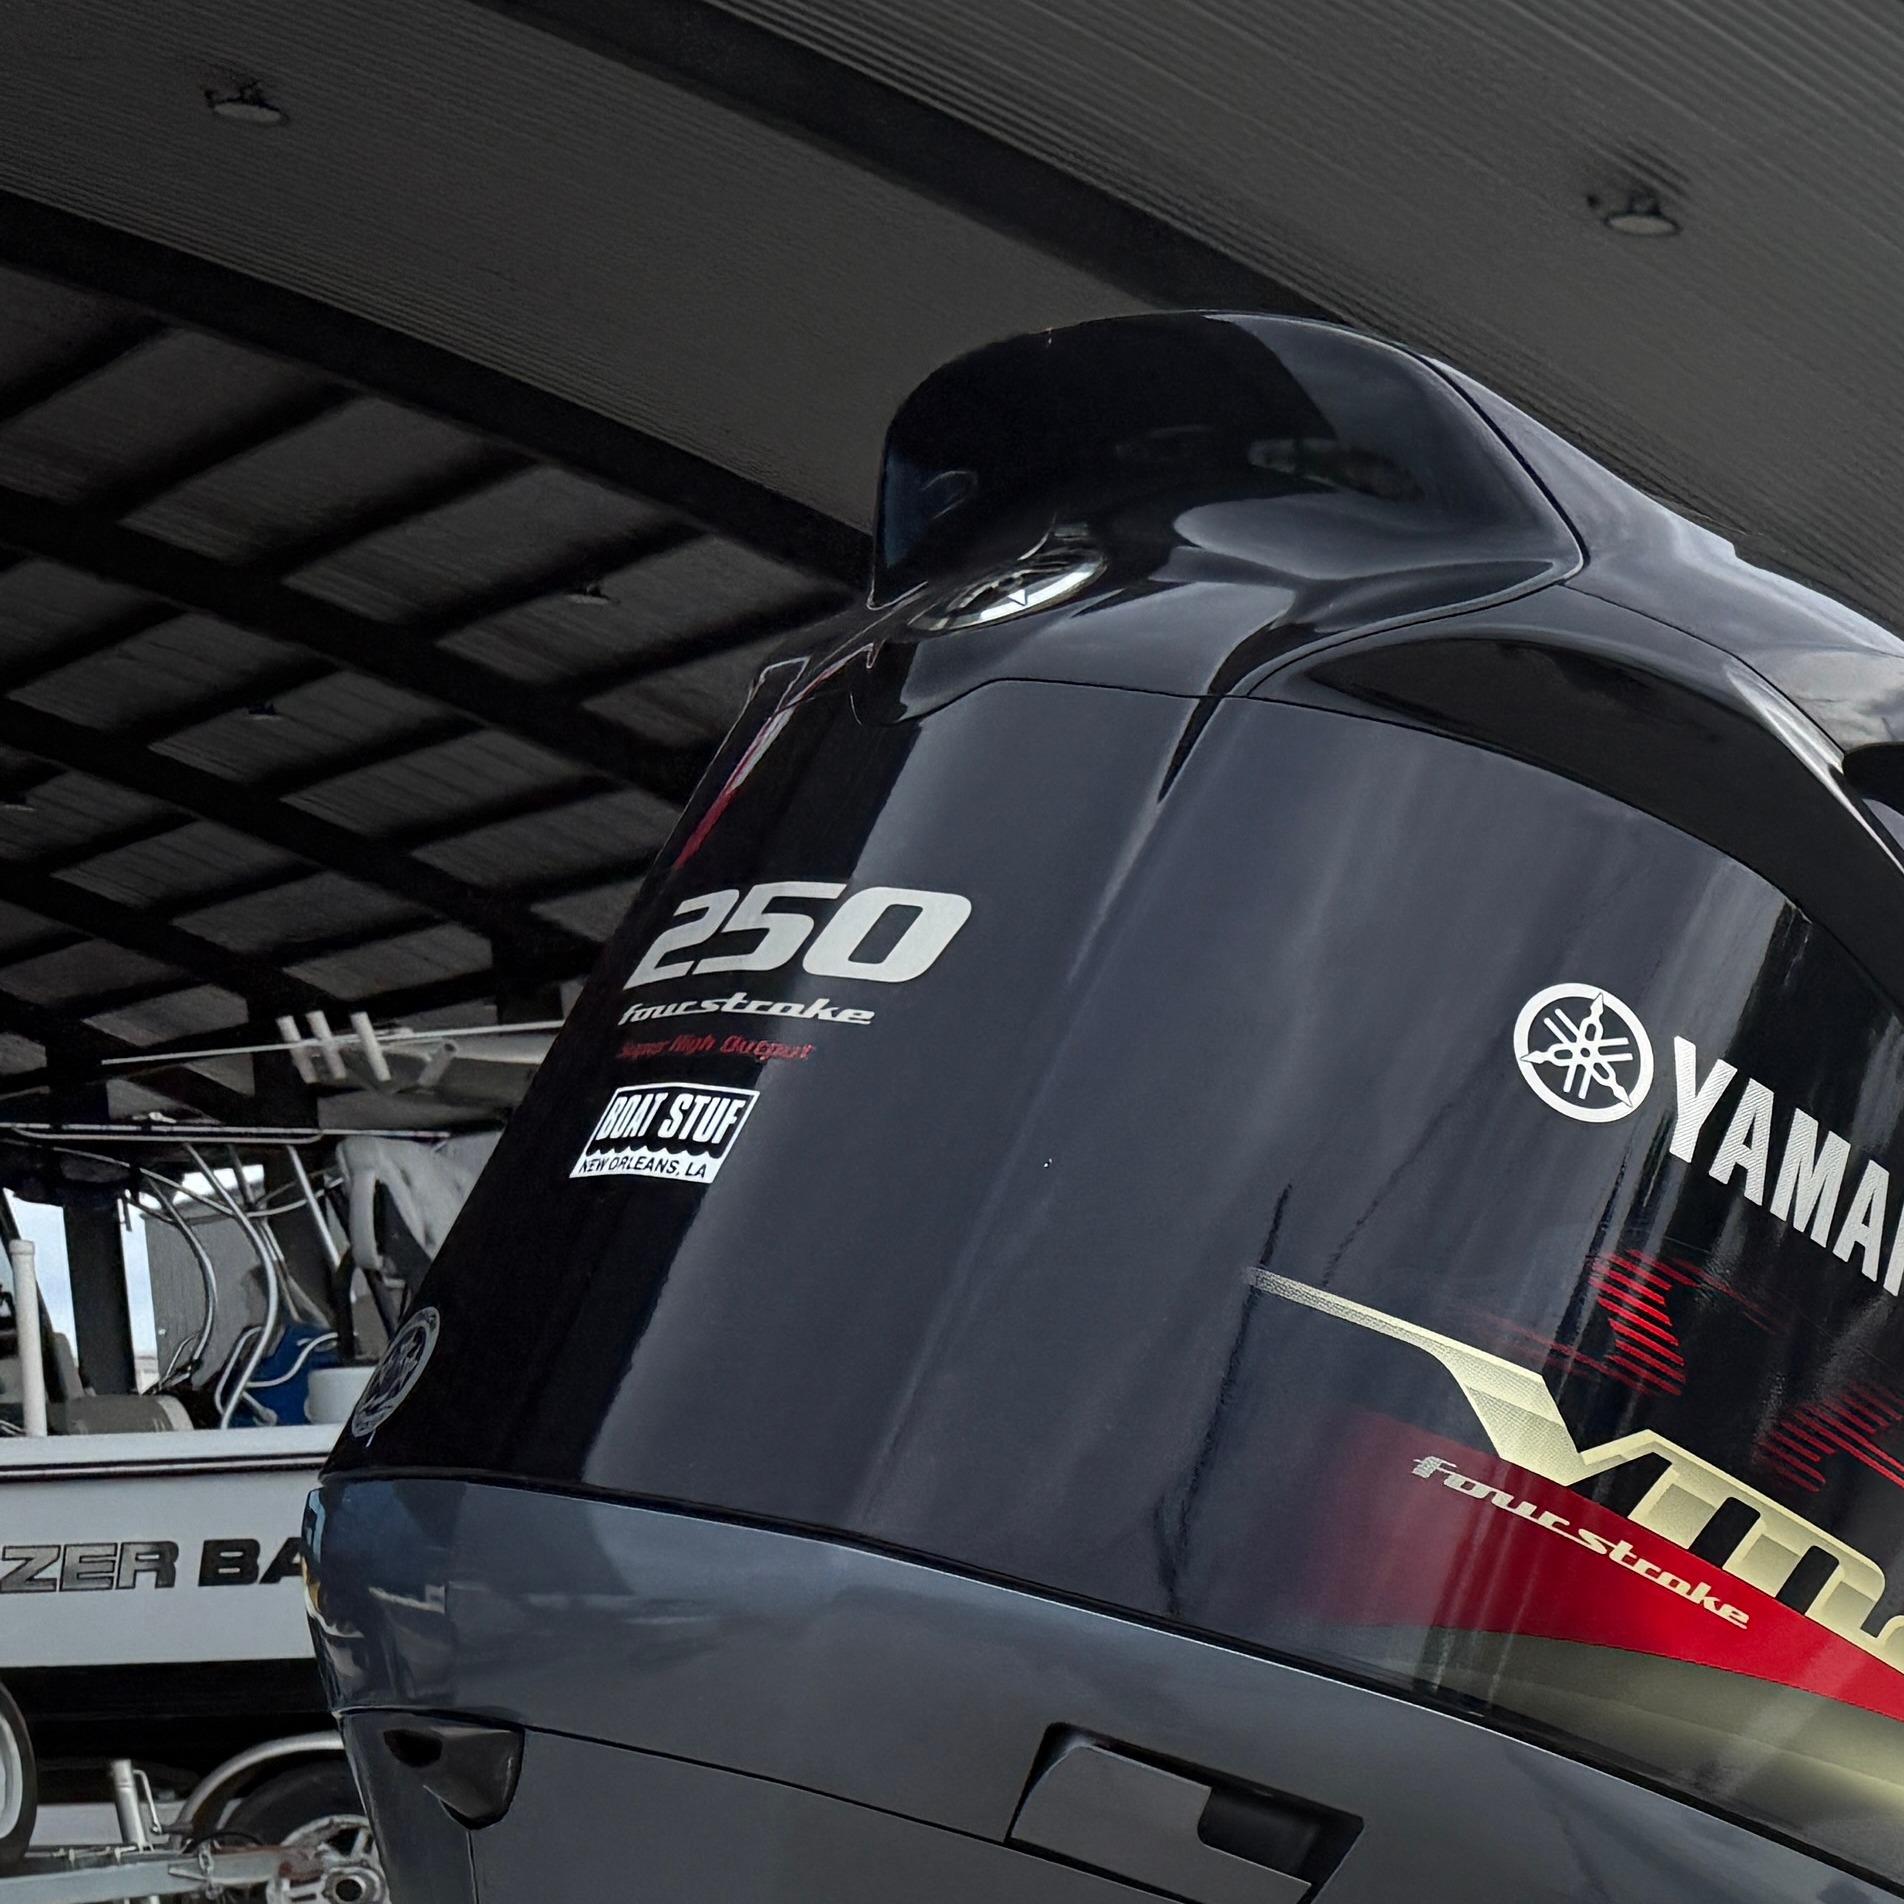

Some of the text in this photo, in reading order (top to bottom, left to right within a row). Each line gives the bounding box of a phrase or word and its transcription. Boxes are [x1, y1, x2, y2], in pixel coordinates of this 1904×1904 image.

[623, 881, 972, 990] 250
[595, 1092, 746, 1145] BOAT STUF
[579, 1156, 707, 1178] NEW ORLEANS, LA
